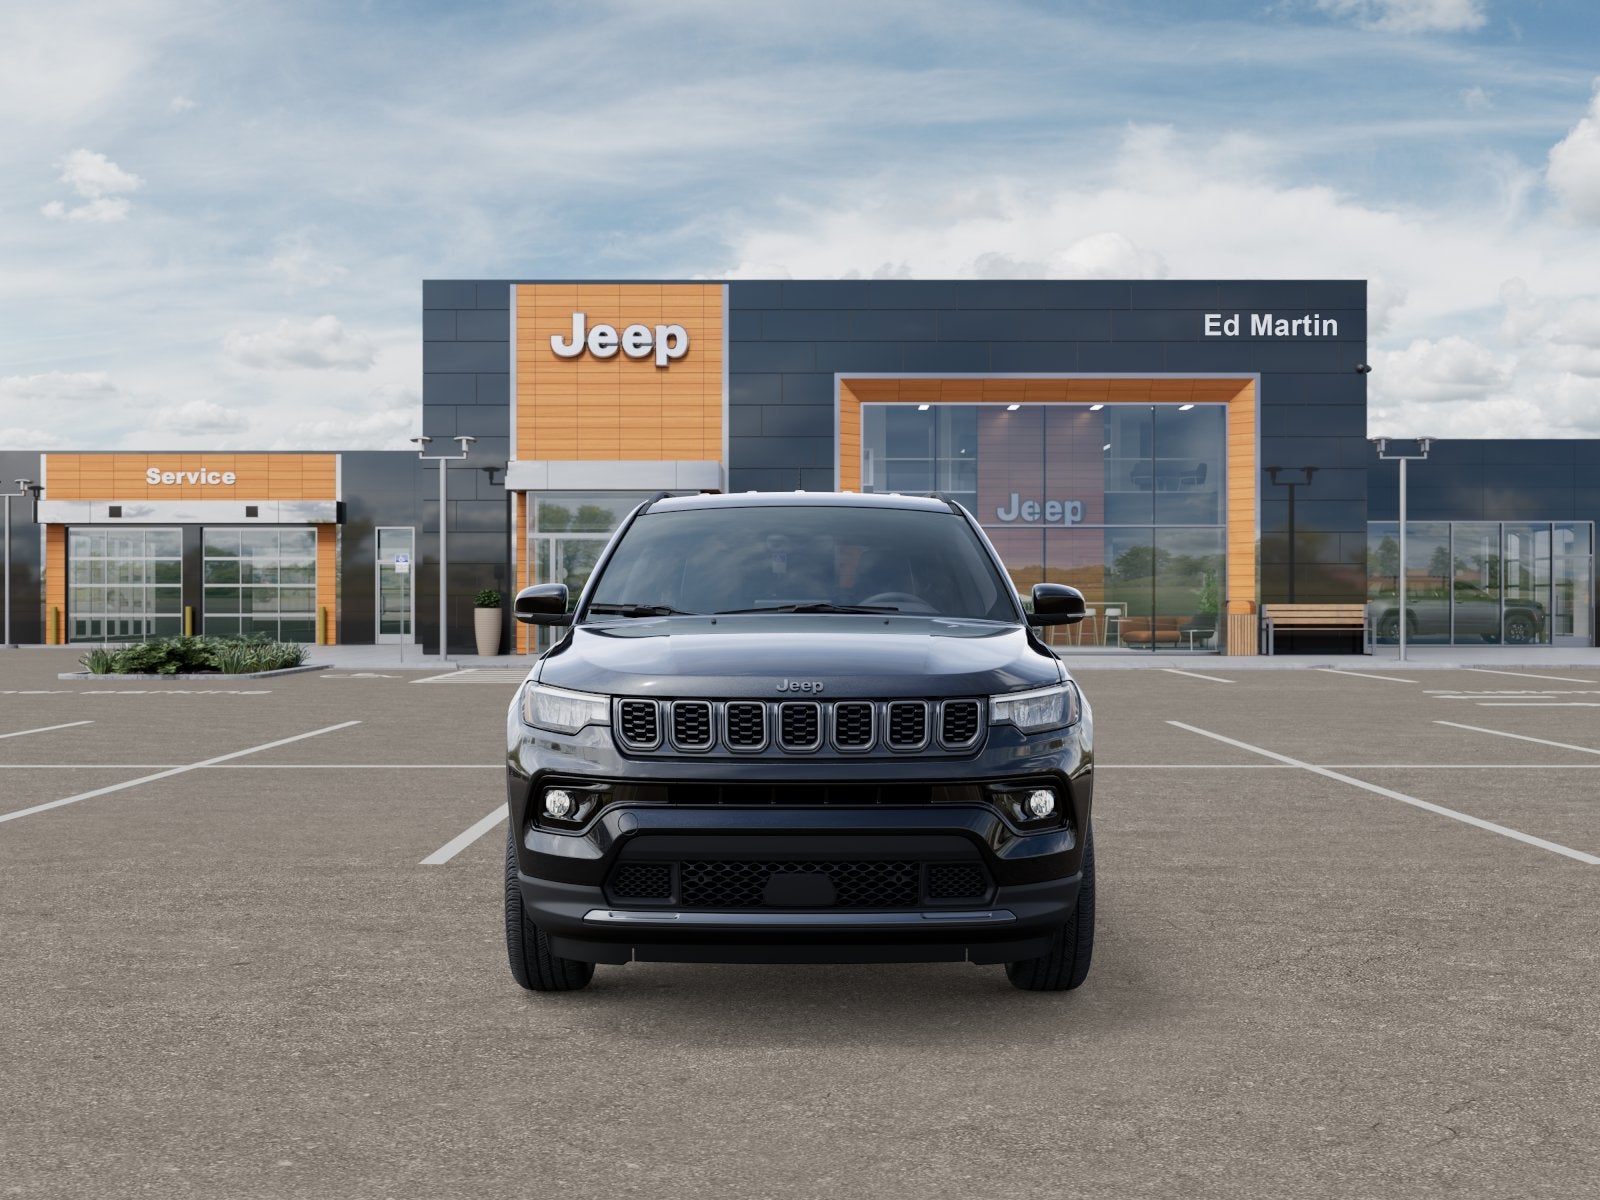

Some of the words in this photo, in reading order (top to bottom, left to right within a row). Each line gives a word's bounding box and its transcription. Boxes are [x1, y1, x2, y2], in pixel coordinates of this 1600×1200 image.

[1204, 313, 1239, 336] Ed
[1250, 313, 1338, 336] Martin
[550, 312, 689, 367] Jeep
[146, 467, 236, 485] Service
[996, 493, 1083, 527] Jeep
[776, 679, 824, 694] Jeep
